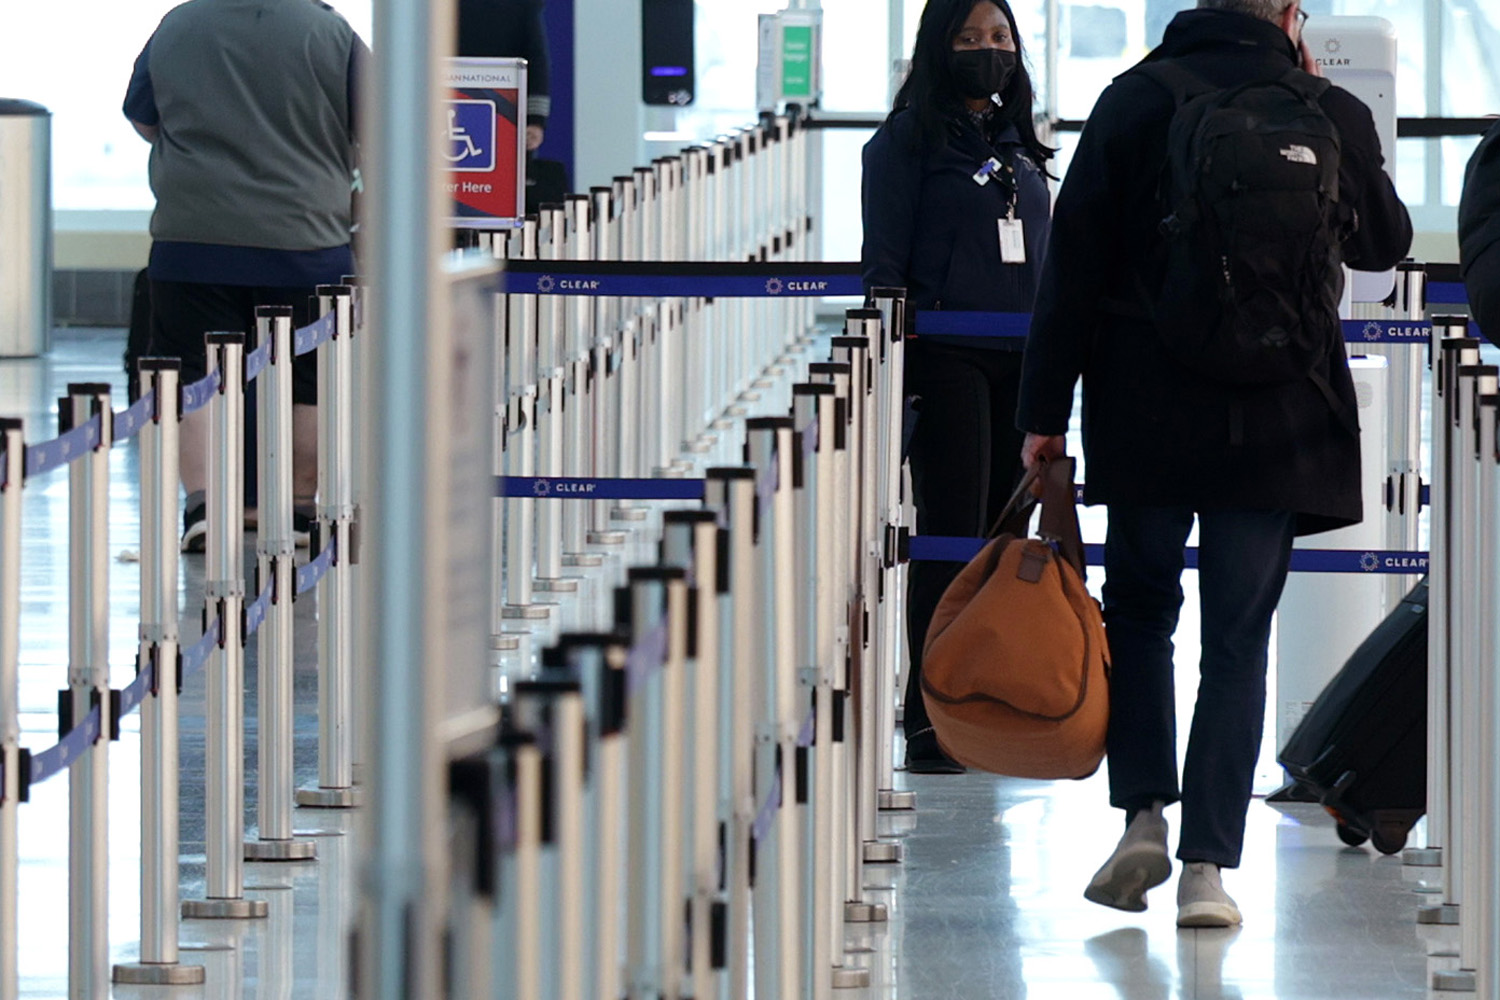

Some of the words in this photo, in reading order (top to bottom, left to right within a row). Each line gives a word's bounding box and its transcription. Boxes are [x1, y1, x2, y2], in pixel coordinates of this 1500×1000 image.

[1315, 58, 1350, 66] CLEAR
[462, 182, 492, 193] Here
[560, 281, 599, 290] CLEAR
[787, 282, 826, 291] CLEAR
[1388, 327, 1430, 336] CLEAR
[556, 483, 595, 492] CLEAR
[1385, 558, 1427, 567] CLEAR
